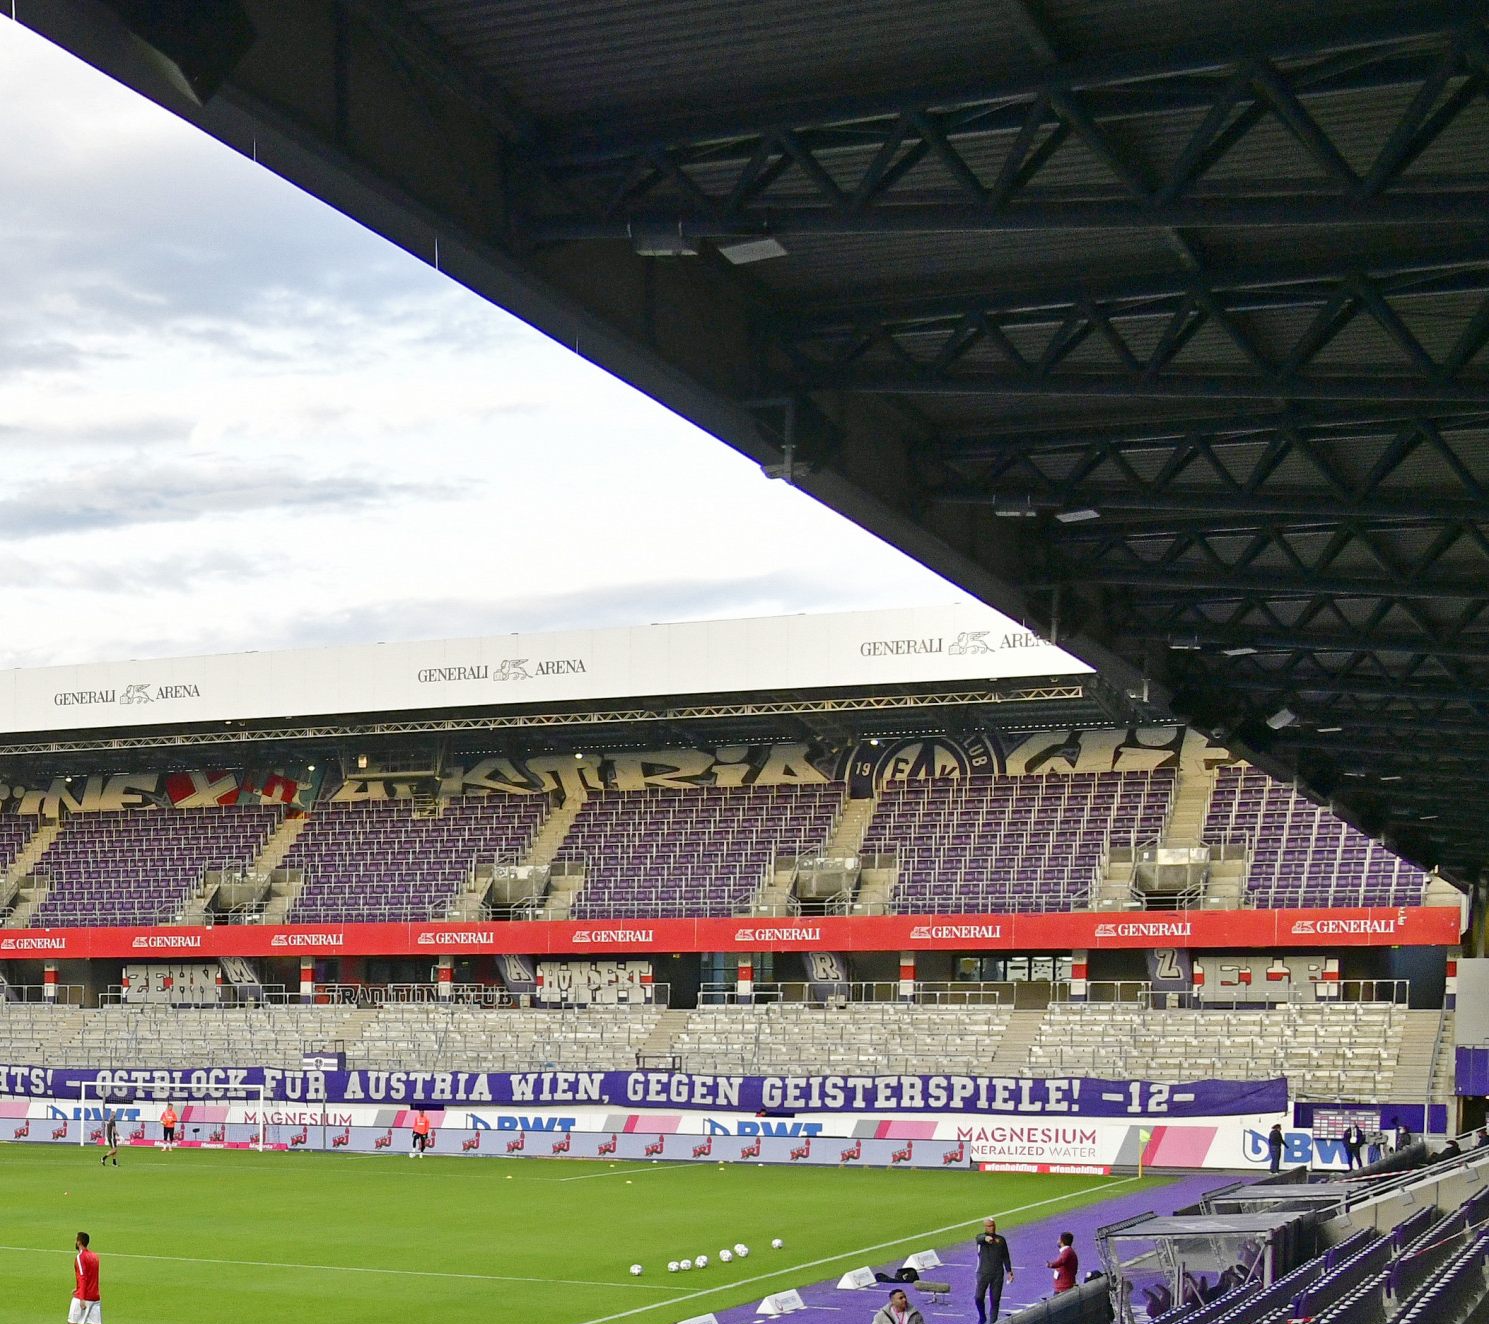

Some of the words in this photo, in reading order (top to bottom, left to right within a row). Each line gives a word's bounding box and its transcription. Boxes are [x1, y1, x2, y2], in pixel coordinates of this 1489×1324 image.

[861, 638, 943, 656] GENERALI
[418, 665, 489, 683] GENERALI
[535, 659, 587, 676] ARENA
[54, 689, 116, 706] GENERALI
[156, 684, 201, 700] ARENA
[855, 761, 871, 776] 19
[931, 925, 1001, 939] GENERALI
[1118, 922, 1192, 937] GENERALI
[1316, 918, 1396, 934] GENERALI
[149, 935, 201, 948] GENERALI
[289, 933, 344, 946] GENERALI
[436, 931, 494, 945] GENERALI
[592, 929, 654, 943] GENERALI
[755, 927, 821, 941] GENERALI
[16, 937, 66, 949] GENERALI
[811, 953, 842, 981] R
[96, 1069, 248, 1098] OSTBLOCK
[344, 1071, 492, 1102] AUSTRIA
[510, 1072, 610, 1104] WIEN,
[627, 1073, 743, 1106] GEGEN
[762, 1075, 1081, 1112] GEISTERSPIELE!
[244, 1110, 352, 1127] MAGNESIUM
[957, 1125, 1097, 1146] MAGNESIUM
[1048, 1147, 1096, 1158] WATER
